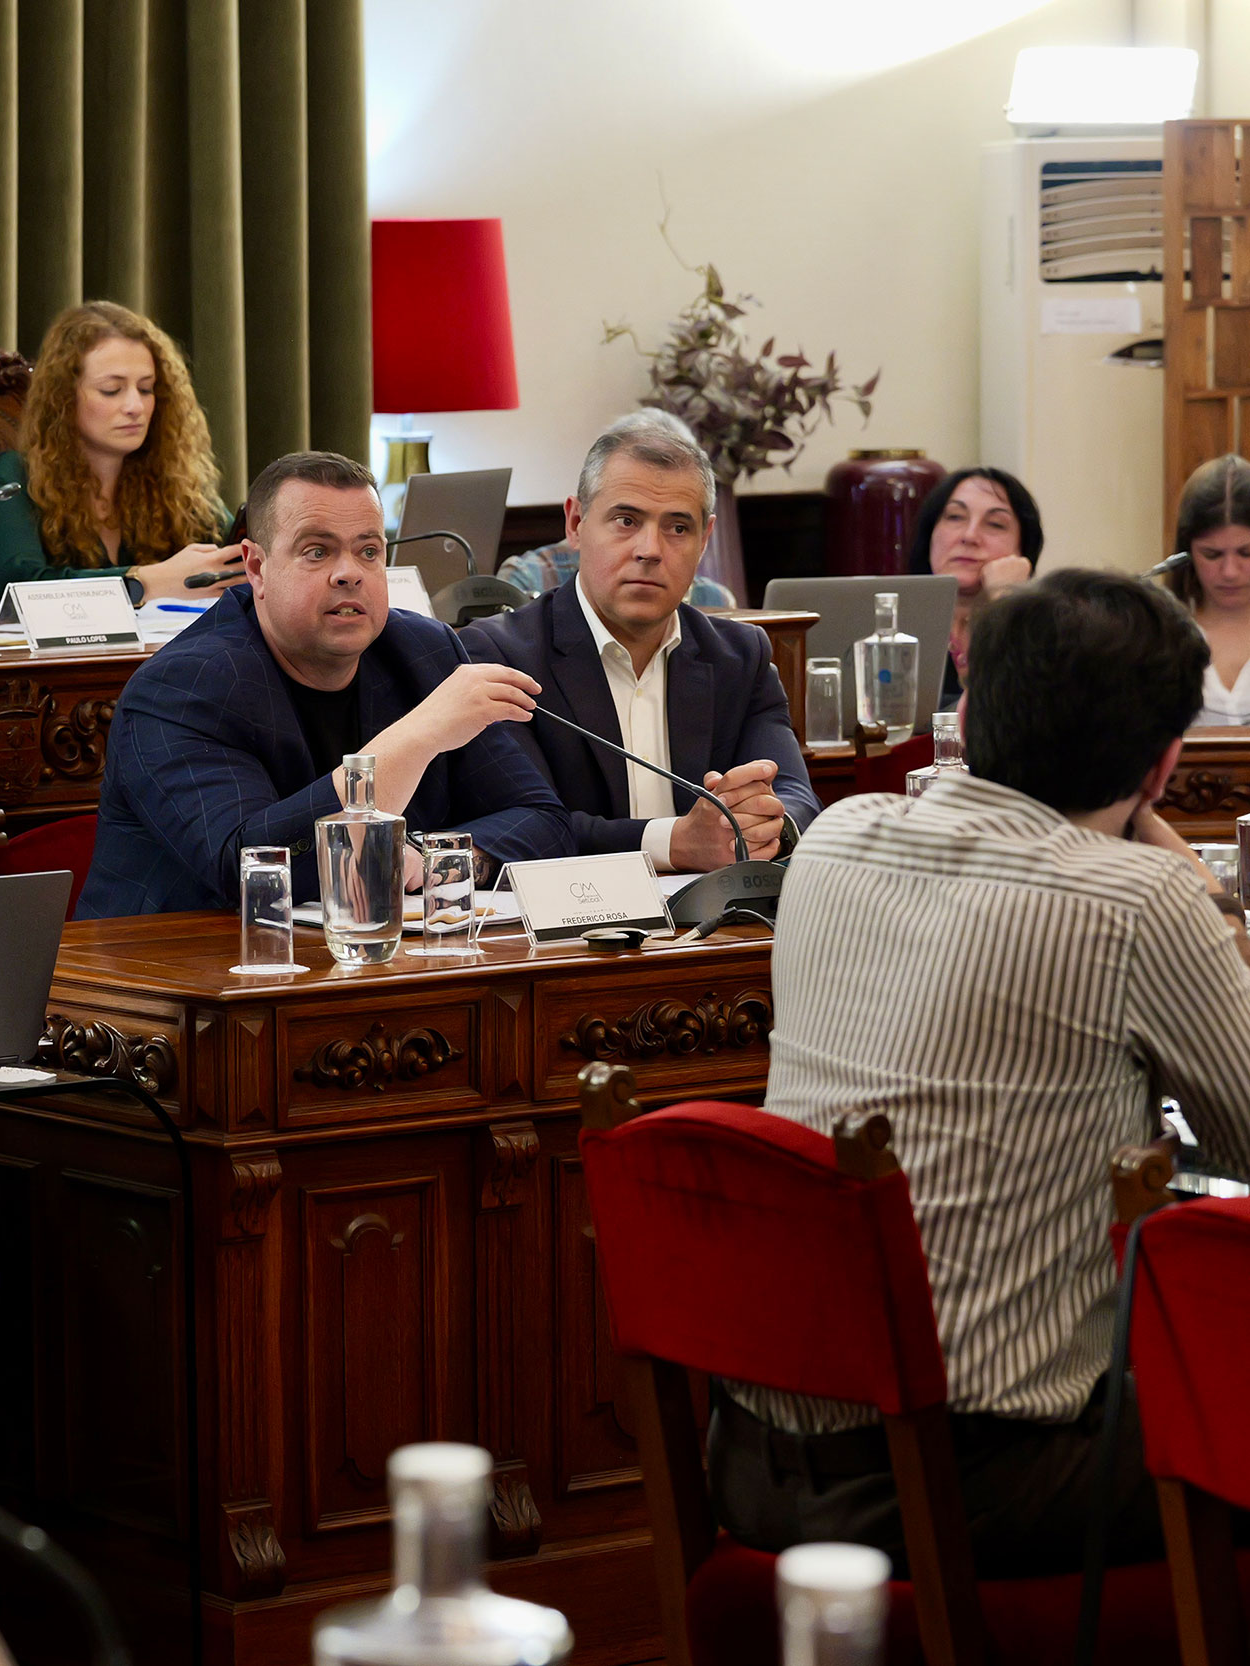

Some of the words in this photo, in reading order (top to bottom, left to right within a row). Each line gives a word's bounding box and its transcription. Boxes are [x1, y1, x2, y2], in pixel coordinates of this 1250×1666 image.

[65, 637, 86, 645] PAULO
[87, 635, 108, 643] LOPES
[742, 873, 782, 889] BOSC
[561, 914, 605, 925] FREDERICO
[606, 911, 629, 921] ROSA
